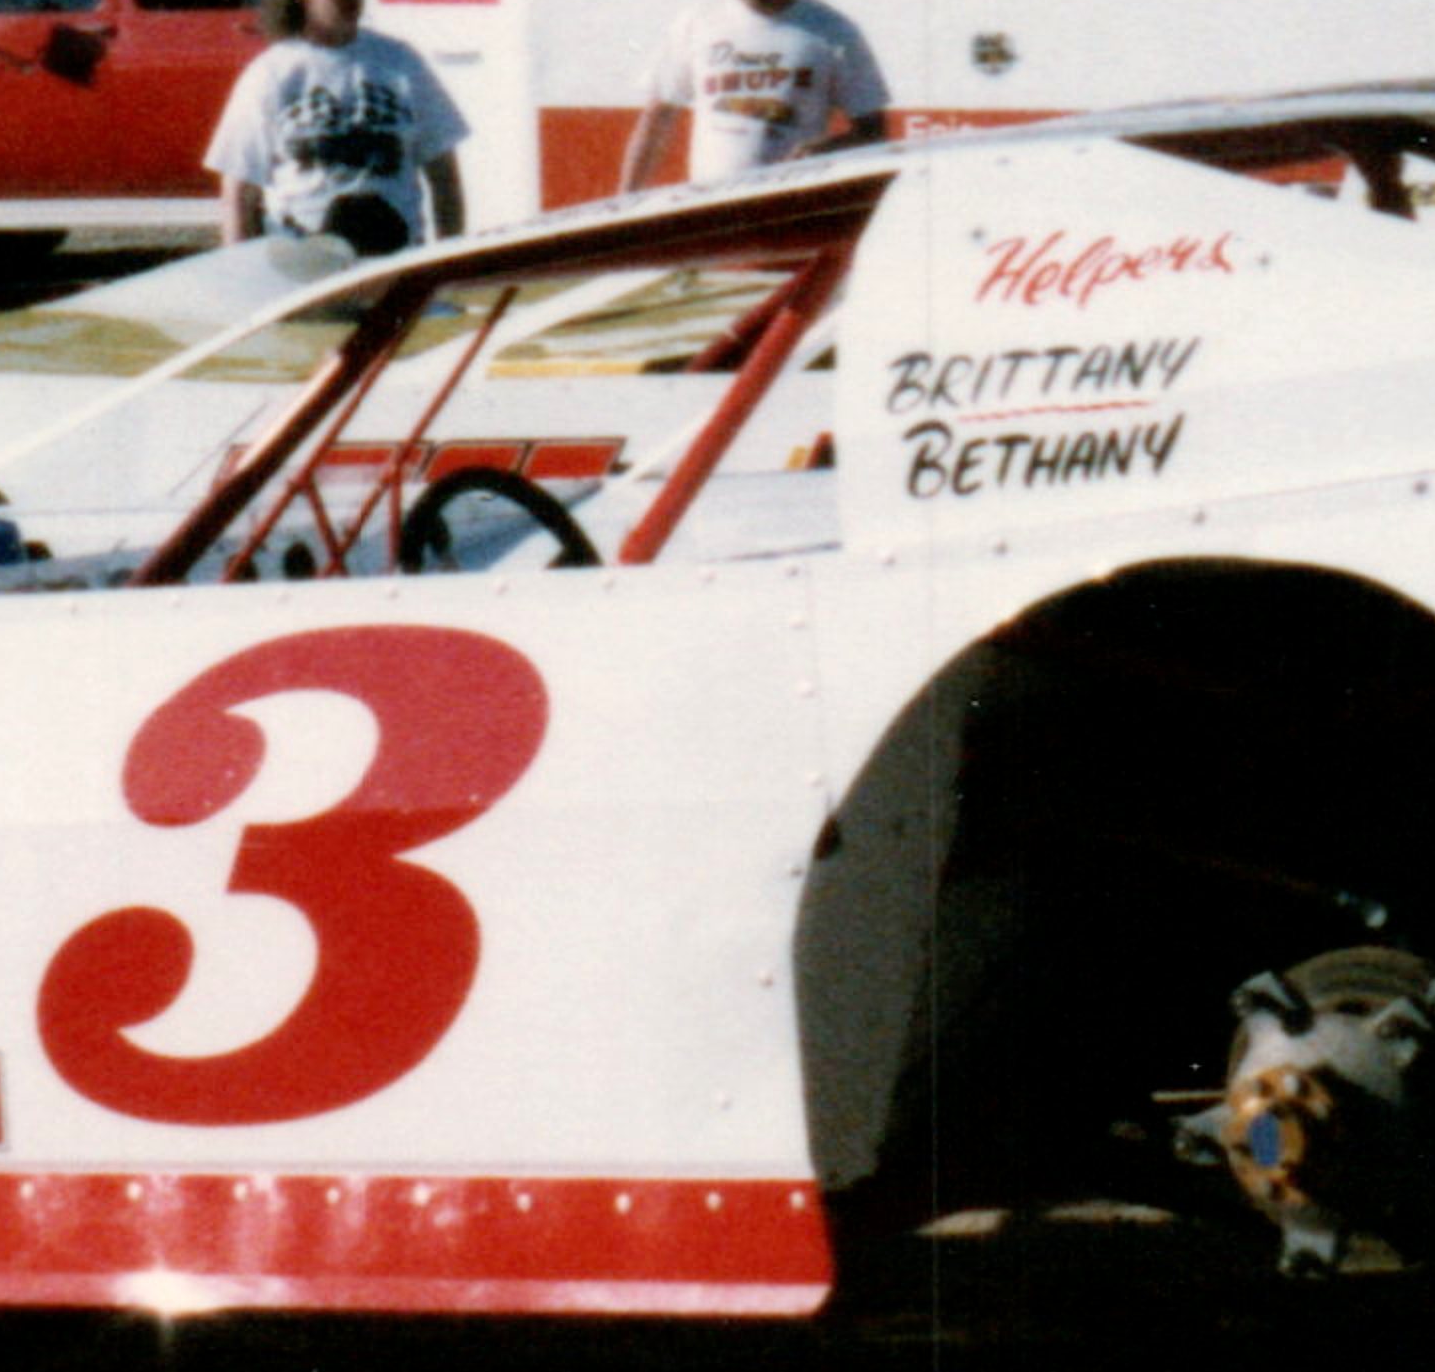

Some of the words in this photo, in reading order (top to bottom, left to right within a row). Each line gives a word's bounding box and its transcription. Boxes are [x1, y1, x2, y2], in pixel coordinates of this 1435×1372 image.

[975, 230, 1236, 308] Helpers
[885, 335, 1202, 414] BRITTANY
[903, 413, 1187, 498] BETHANY
[37, 623, 550, 1128] 3
